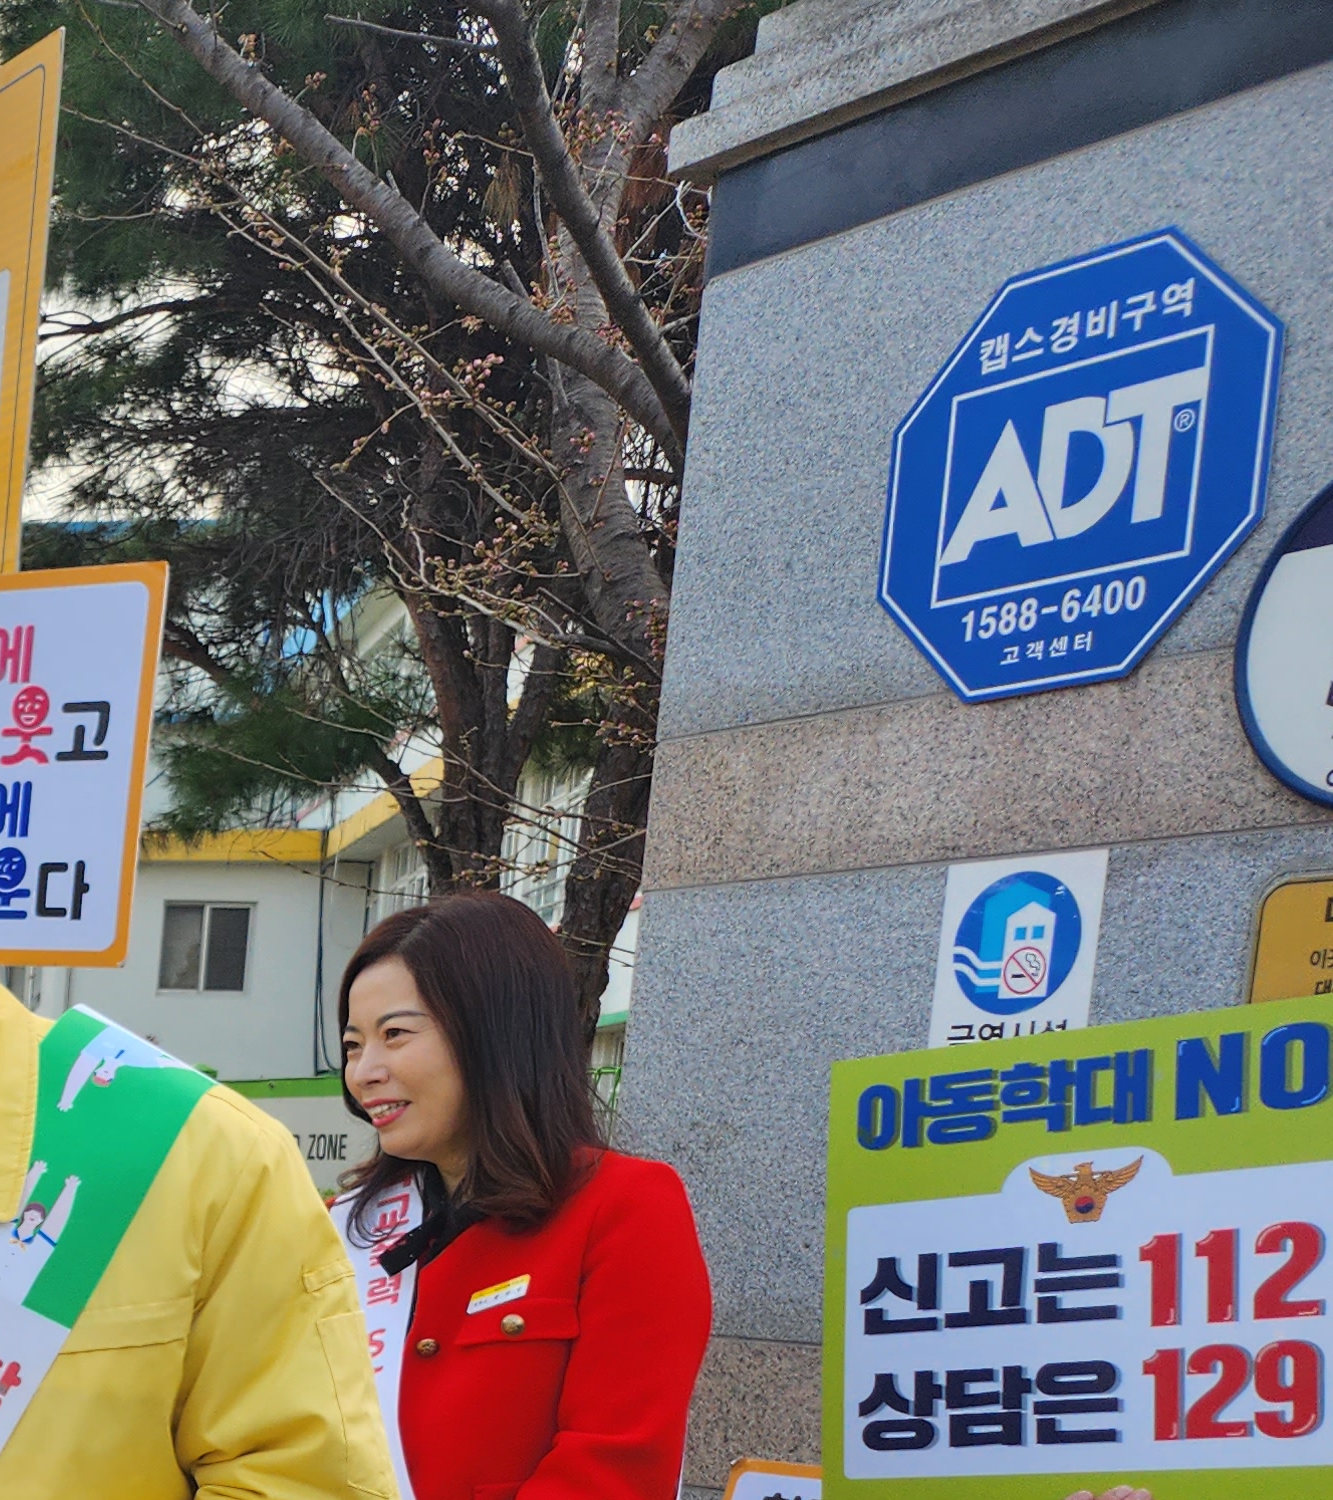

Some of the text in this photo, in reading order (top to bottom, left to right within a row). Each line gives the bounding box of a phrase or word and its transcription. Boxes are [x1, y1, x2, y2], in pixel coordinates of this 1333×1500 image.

[979, 278, 1196, 376] 캡스경비구역
[939, 366, 1209, 567] ADT
[961, 575, 1147, 642] 1588-6400
[1000, 631, 1093, 665] 고객센터
[307, 1134, 348, 1160] ZONE
[856, 1048, 1154, 1151] 아동학대
[859, 1221, 1326, 1337] 신고는 112
[858, 1340, 1328, 1452] 상담은 129
